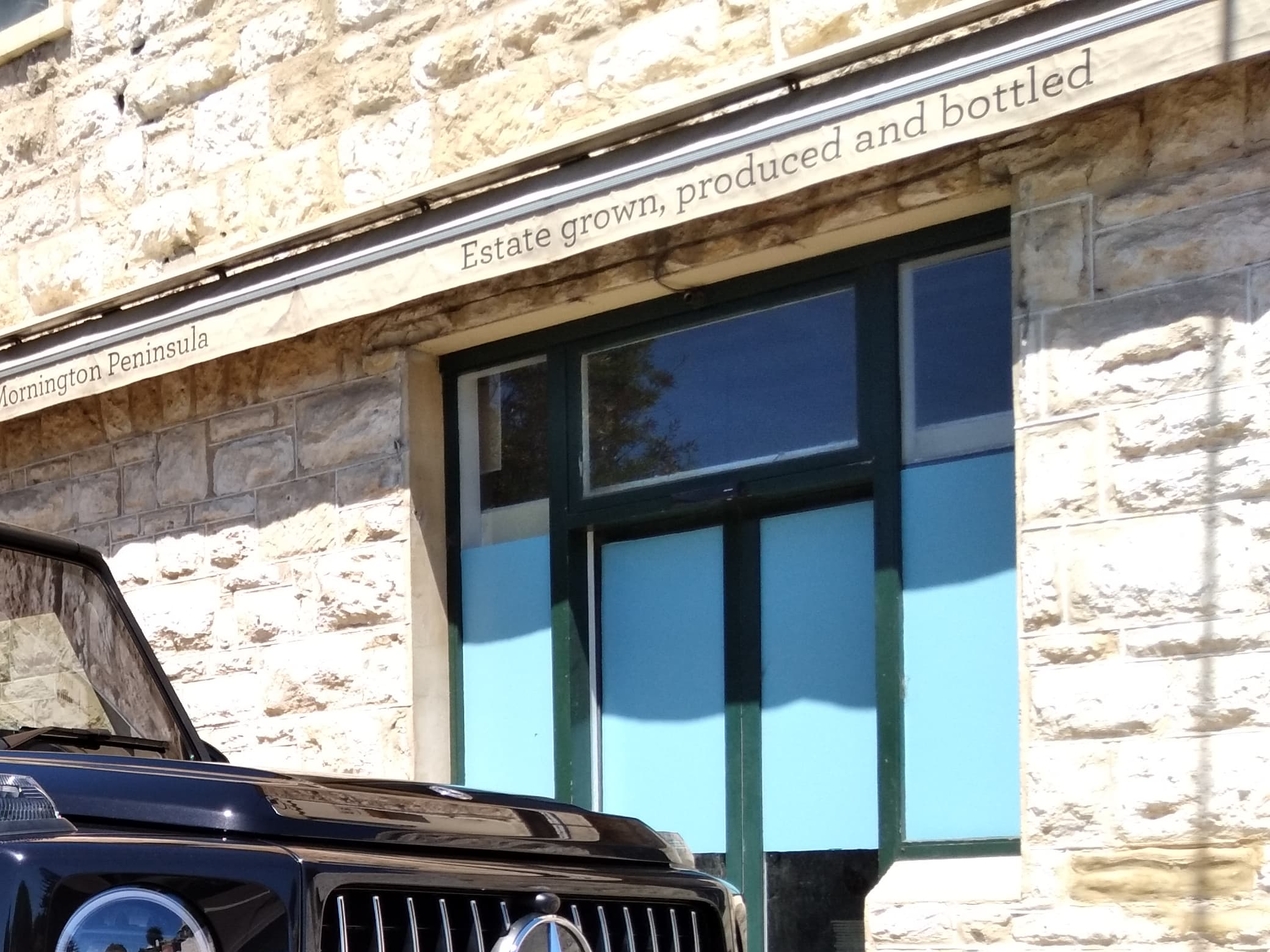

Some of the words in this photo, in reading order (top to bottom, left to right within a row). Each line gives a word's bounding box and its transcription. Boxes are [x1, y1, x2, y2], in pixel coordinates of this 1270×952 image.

[460, 228, 551, 271] Estate
[561, 194, 666, 248] grown,
[676, 125, 842, 215] produced
[855, 100, 928, 153] and
[939, 49, 1094, 129] bottled
[107, 328, 209, 377] Peninsula
